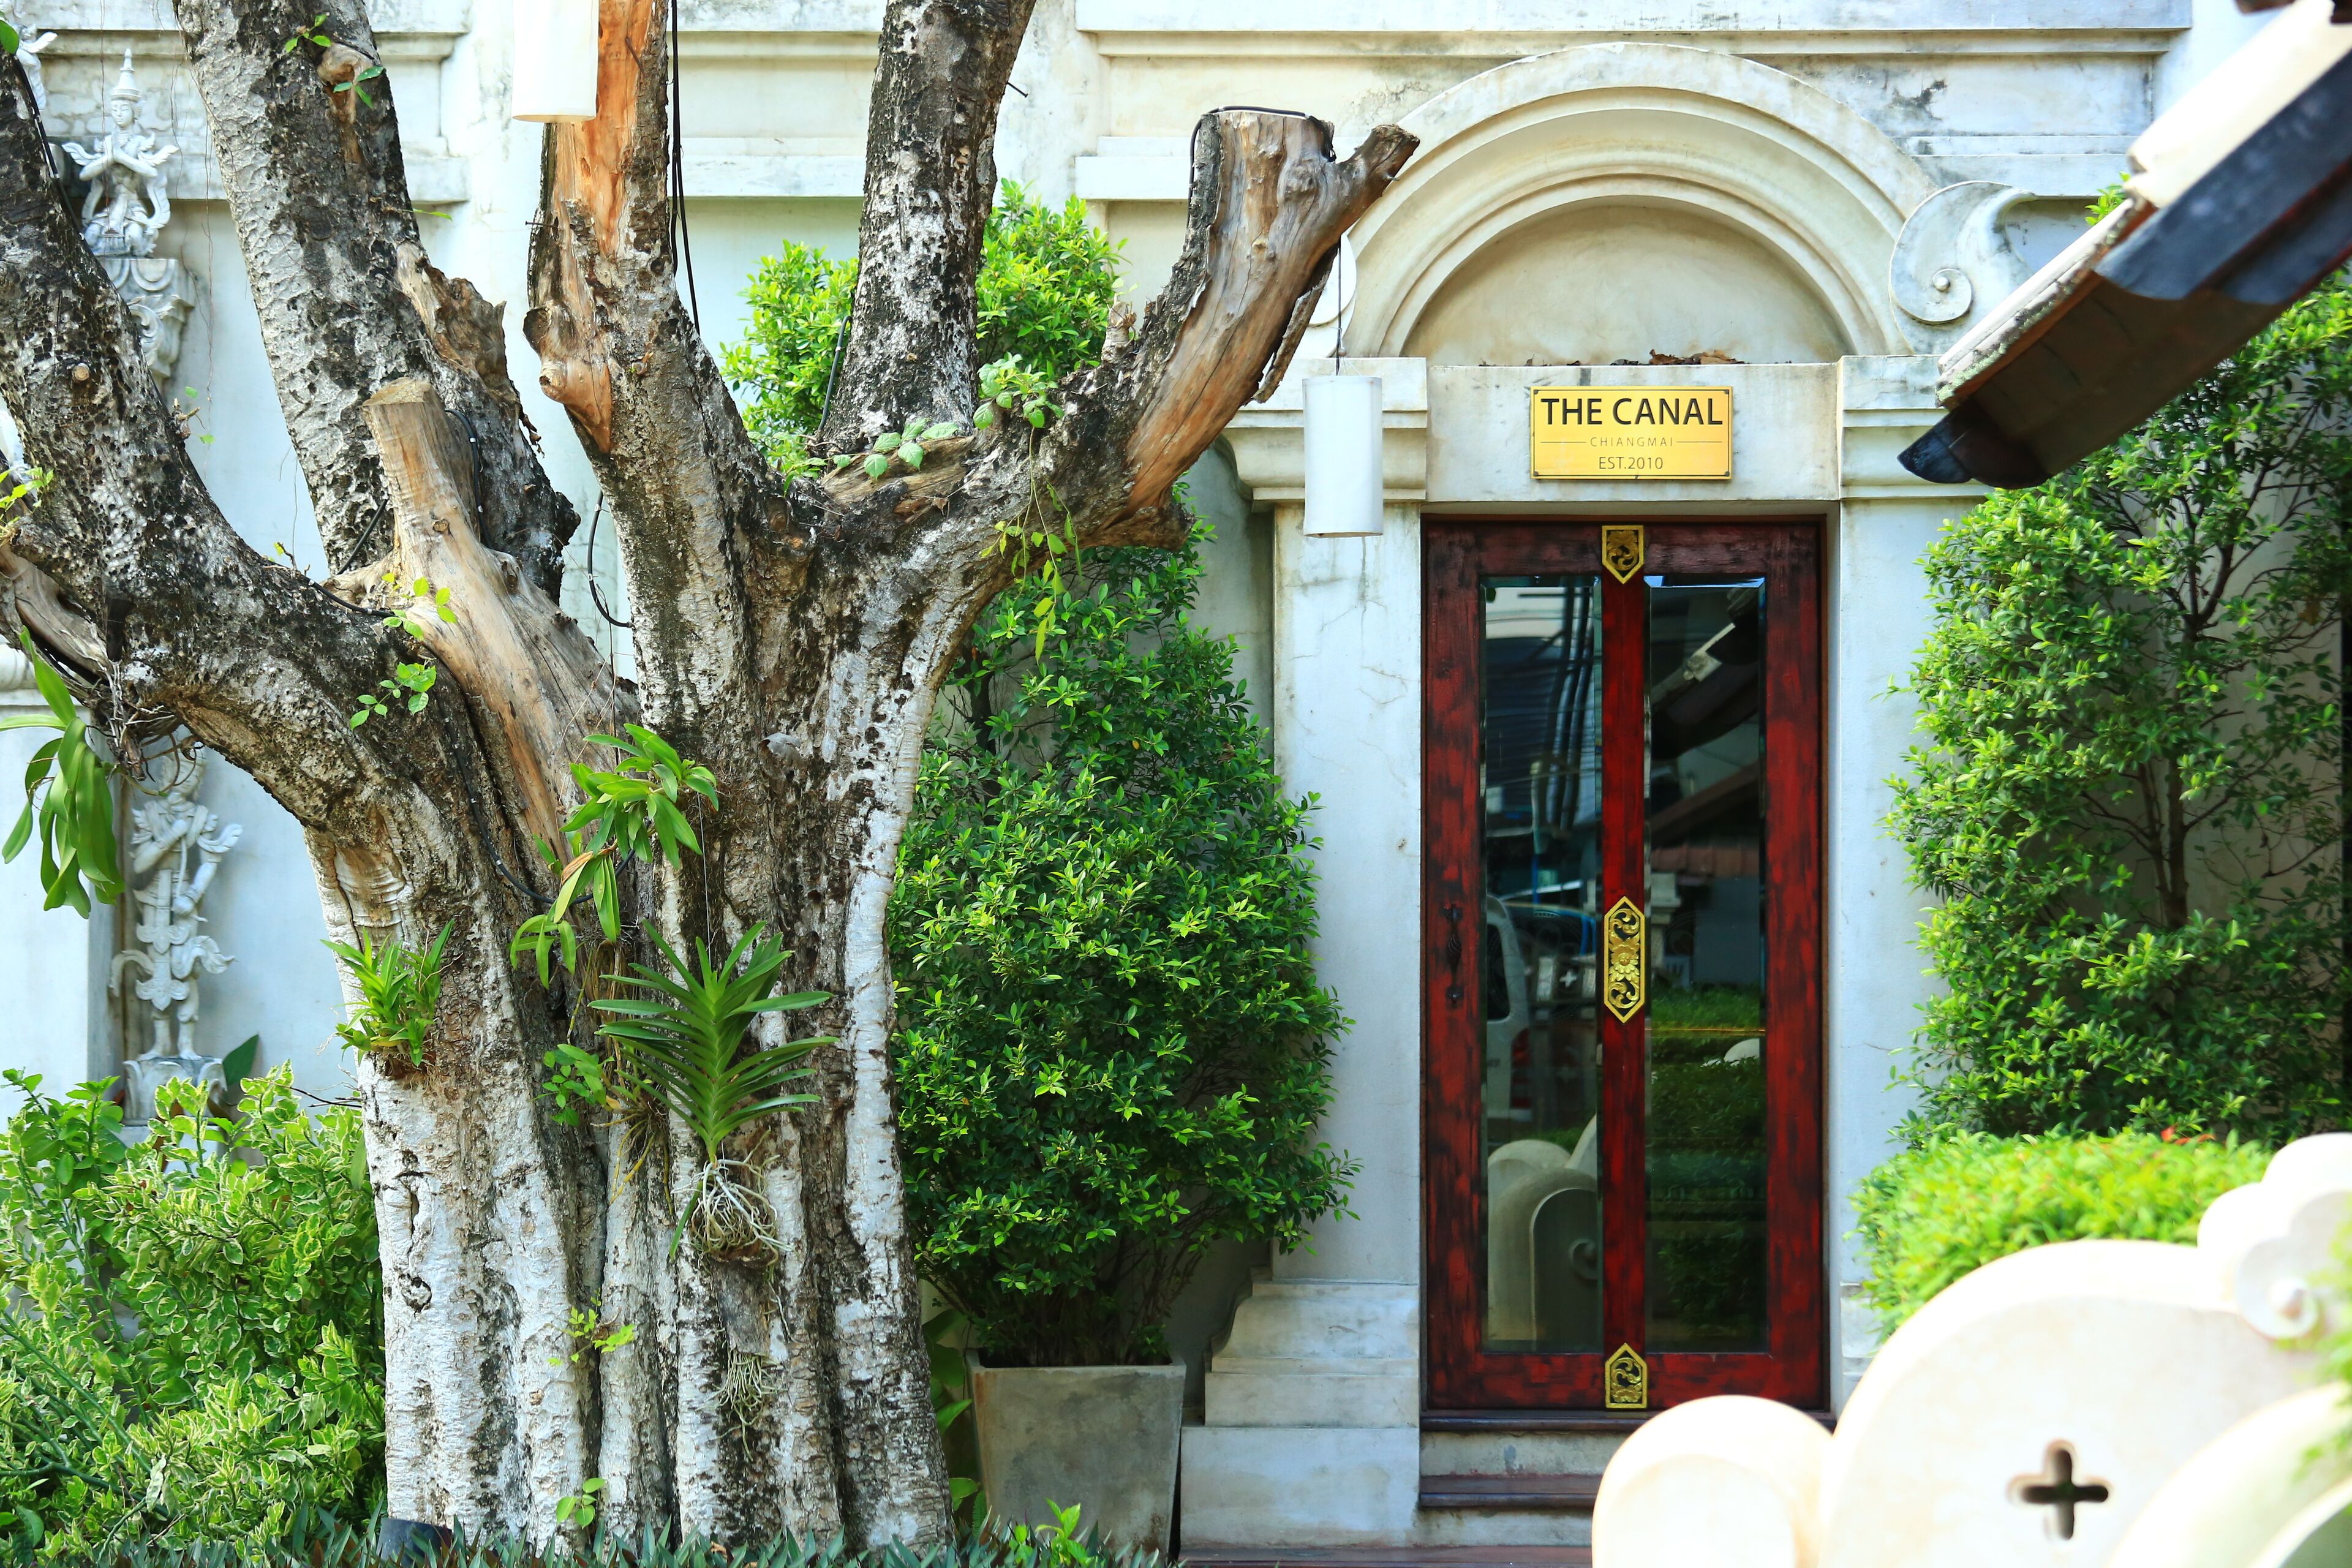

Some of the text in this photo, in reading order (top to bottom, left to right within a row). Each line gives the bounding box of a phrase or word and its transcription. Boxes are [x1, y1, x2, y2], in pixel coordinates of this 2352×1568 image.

[1540, 398, 1723, 424] THE CANAL
[1589, 437, 1673, 447] CHIANGMAI
[1599, 456, 1664, 469] EST.2010
